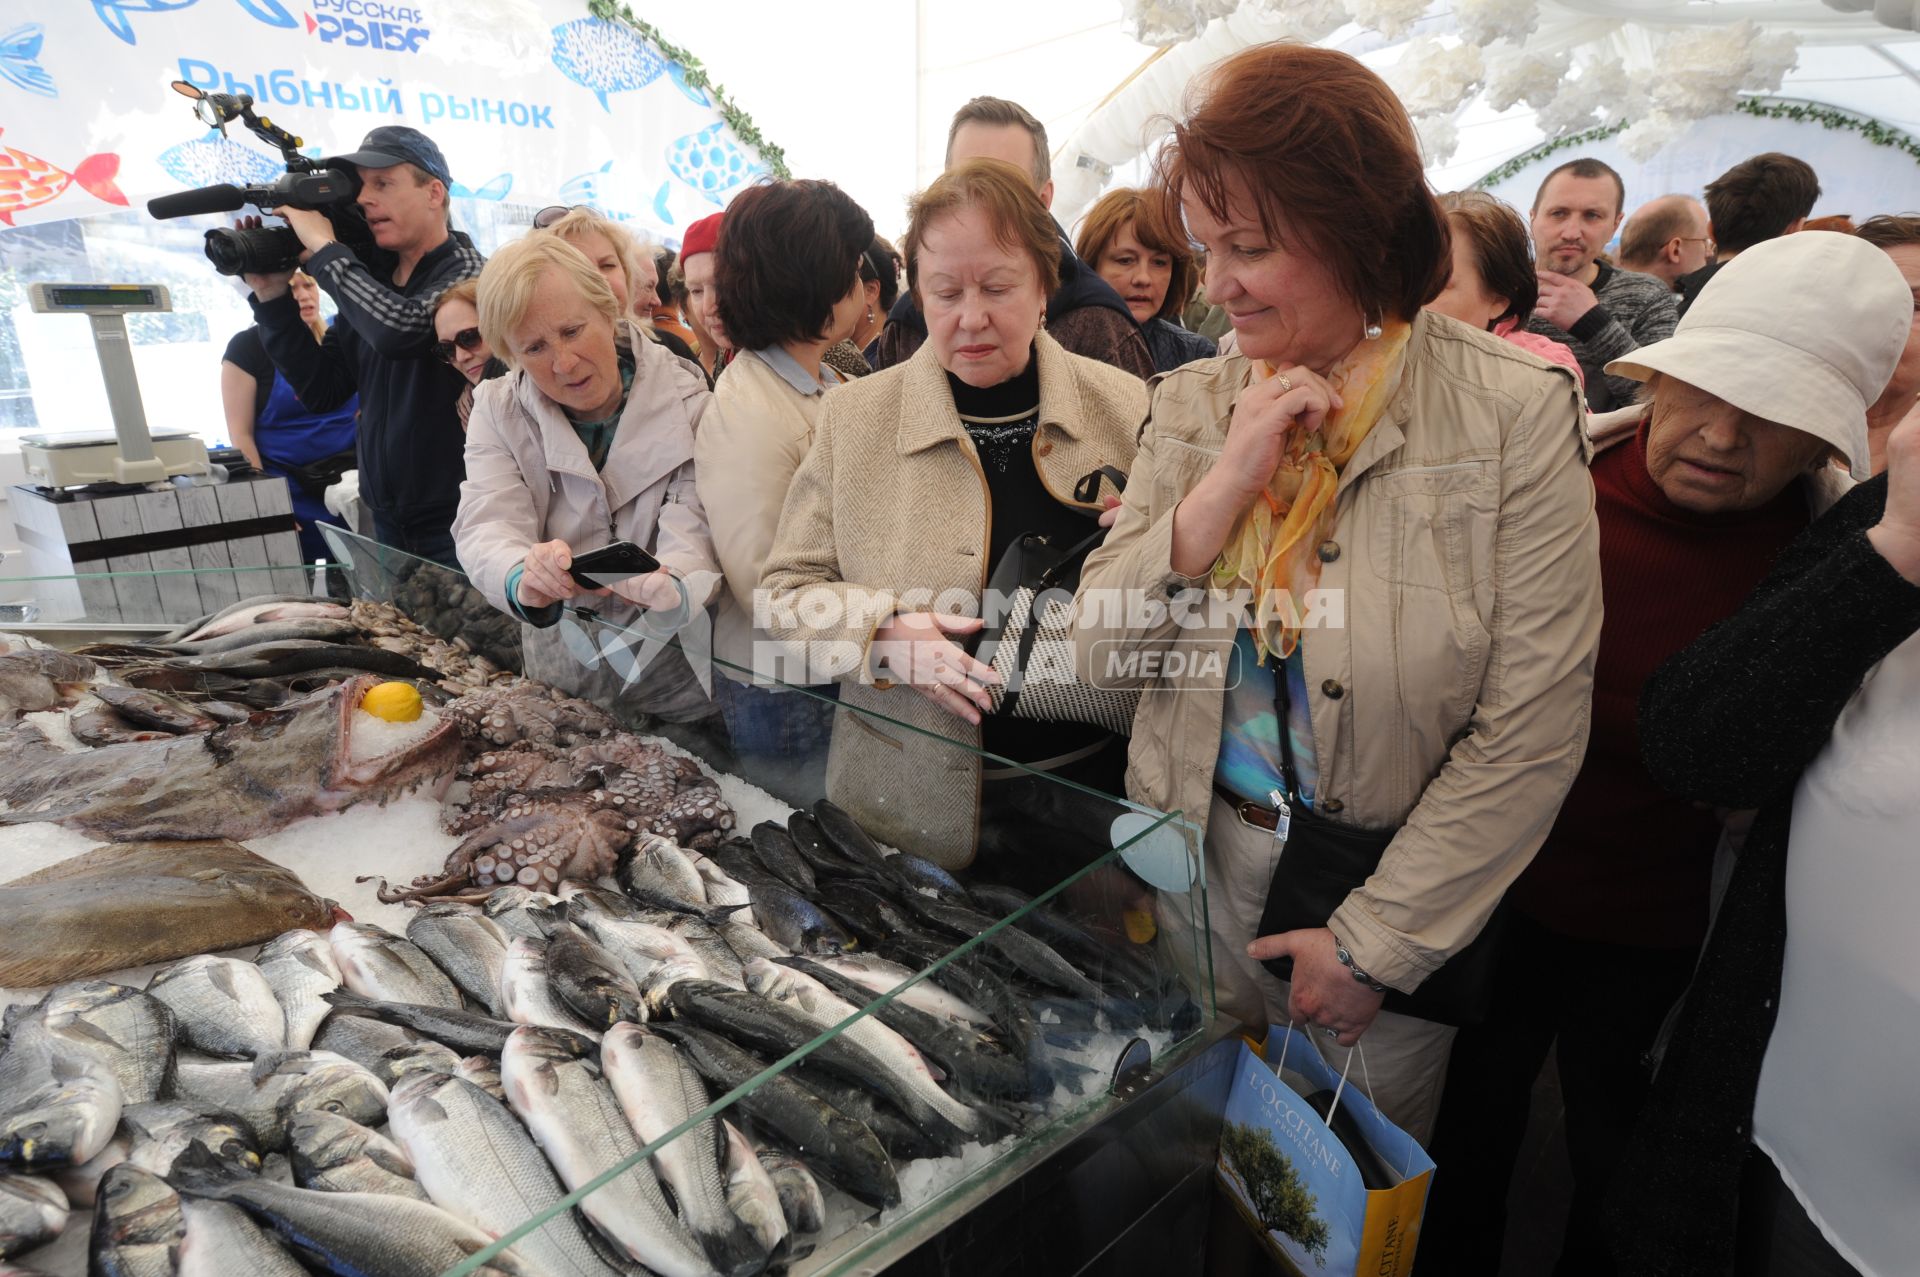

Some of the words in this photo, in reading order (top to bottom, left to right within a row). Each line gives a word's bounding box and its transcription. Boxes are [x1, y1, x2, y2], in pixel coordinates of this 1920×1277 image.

[178, 58, 404, 114] Рыбный
[419, 92, 555, 129] рынок
[1250, 1071, 1342, 1178] L'OCCITANE
[1275, 1118, 1318, 1169] PROVENCE
[1378, 1215, 1400, 1277] CITANE
